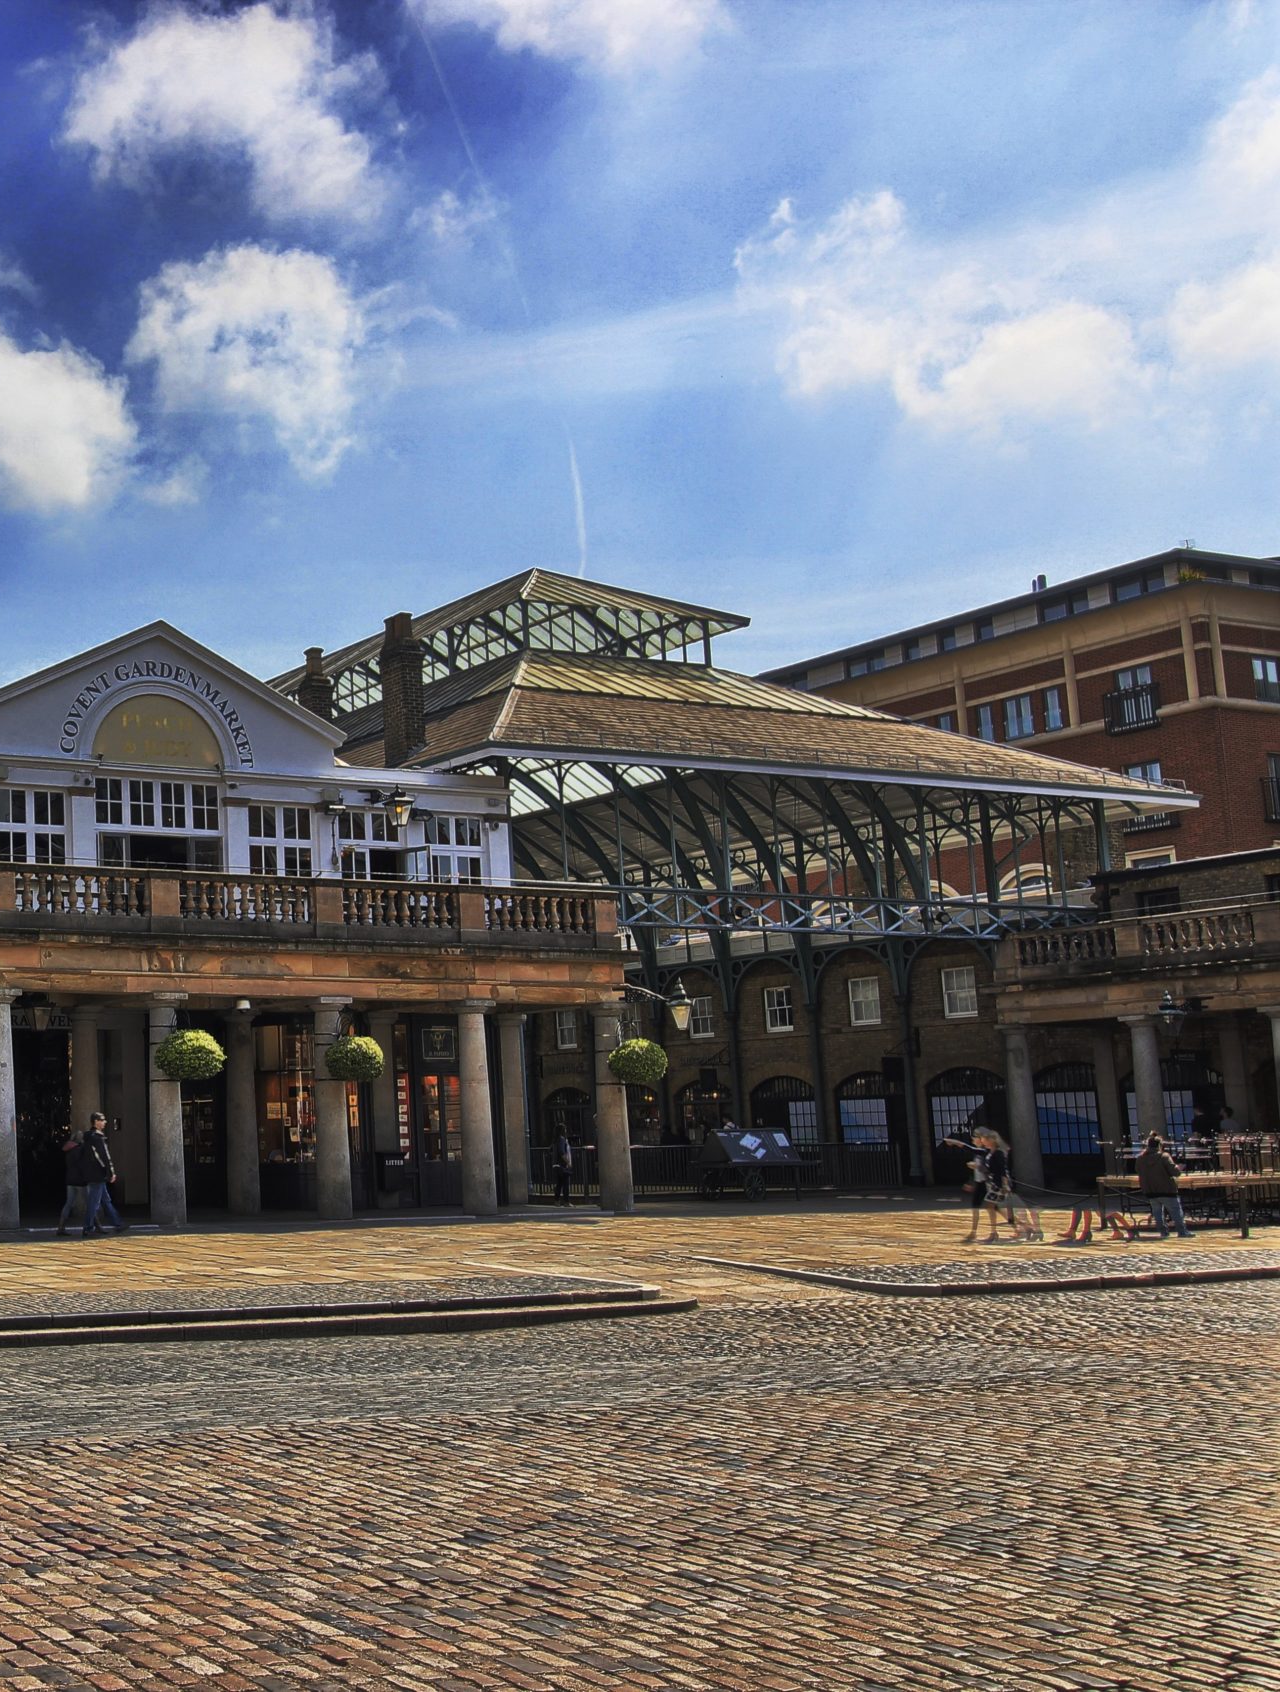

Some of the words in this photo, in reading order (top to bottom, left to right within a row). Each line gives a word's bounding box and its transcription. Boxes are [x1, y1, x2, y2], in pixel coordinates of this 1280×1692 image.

[59, 672, 112, 753] COVENT
[114, 660, 202, 691] GARDEN
[201, 683, 254, 768] MARKET
